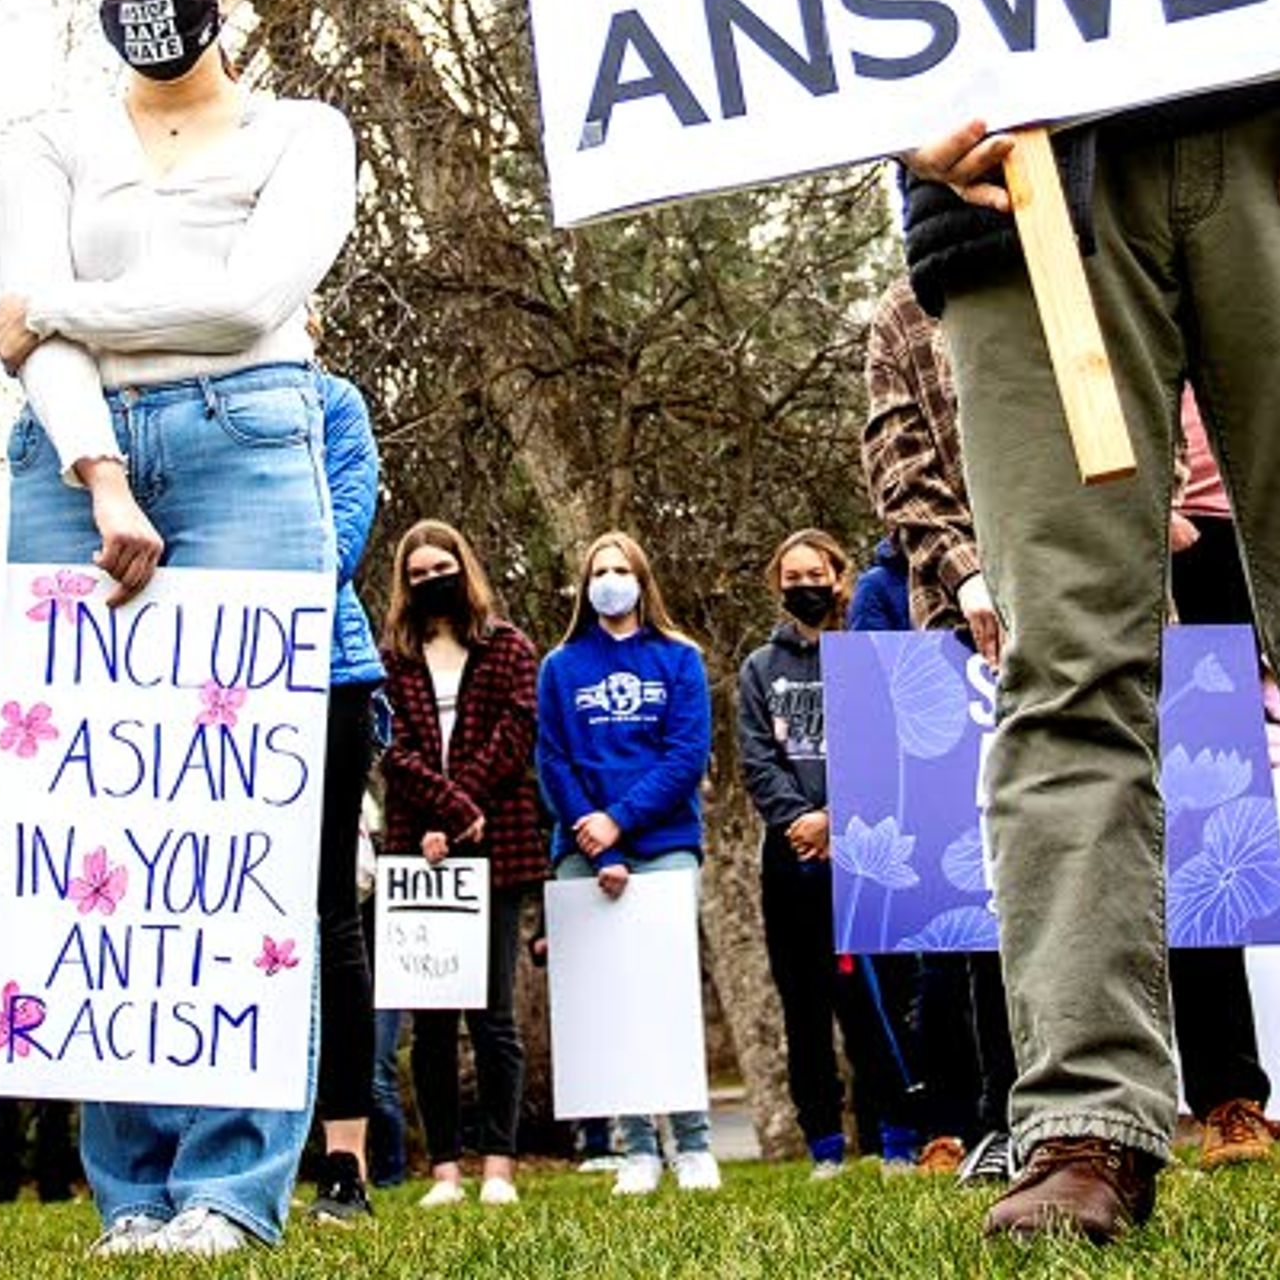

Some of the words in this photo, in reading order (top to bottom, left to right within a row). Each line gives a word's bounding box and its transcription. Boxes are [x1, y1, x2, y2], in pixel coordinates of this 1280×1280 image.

[126, 21, 176, 40] AAPI
[128, 39, 179, 59] HATE
[44, 597, 328, 694] INCLUDE
[49, 717, 309, 806] ASIANS
[16, 822, 75, 900] IN
[124, 828, 287, 916] YOUR
[388, 867, 478, 900] HATE
[45, 922, 232, 991] ANTI-
[6, 994, 259, 1072] RACISM
